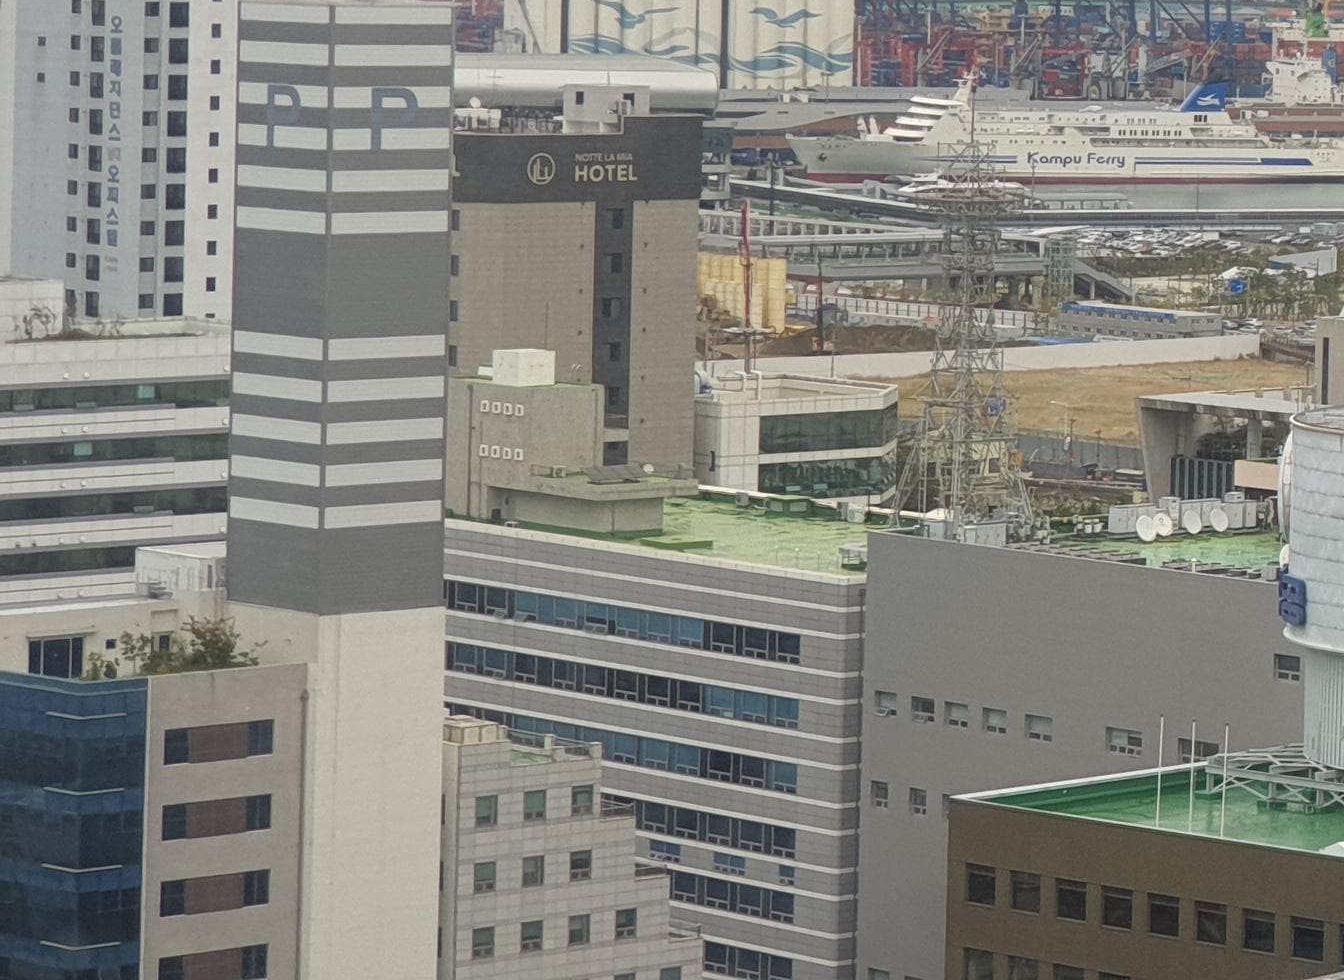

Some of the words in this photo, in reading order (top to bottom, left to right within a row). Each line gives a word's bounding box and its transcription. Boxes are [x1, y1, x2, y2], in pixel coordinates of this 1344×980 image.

[370, 86, 419, 152] P
[1027, 151, 1082, 168] Kampu
[1087, 152, 1126, 168] Ferry
[574, 164, 638, 182] HOTEL
